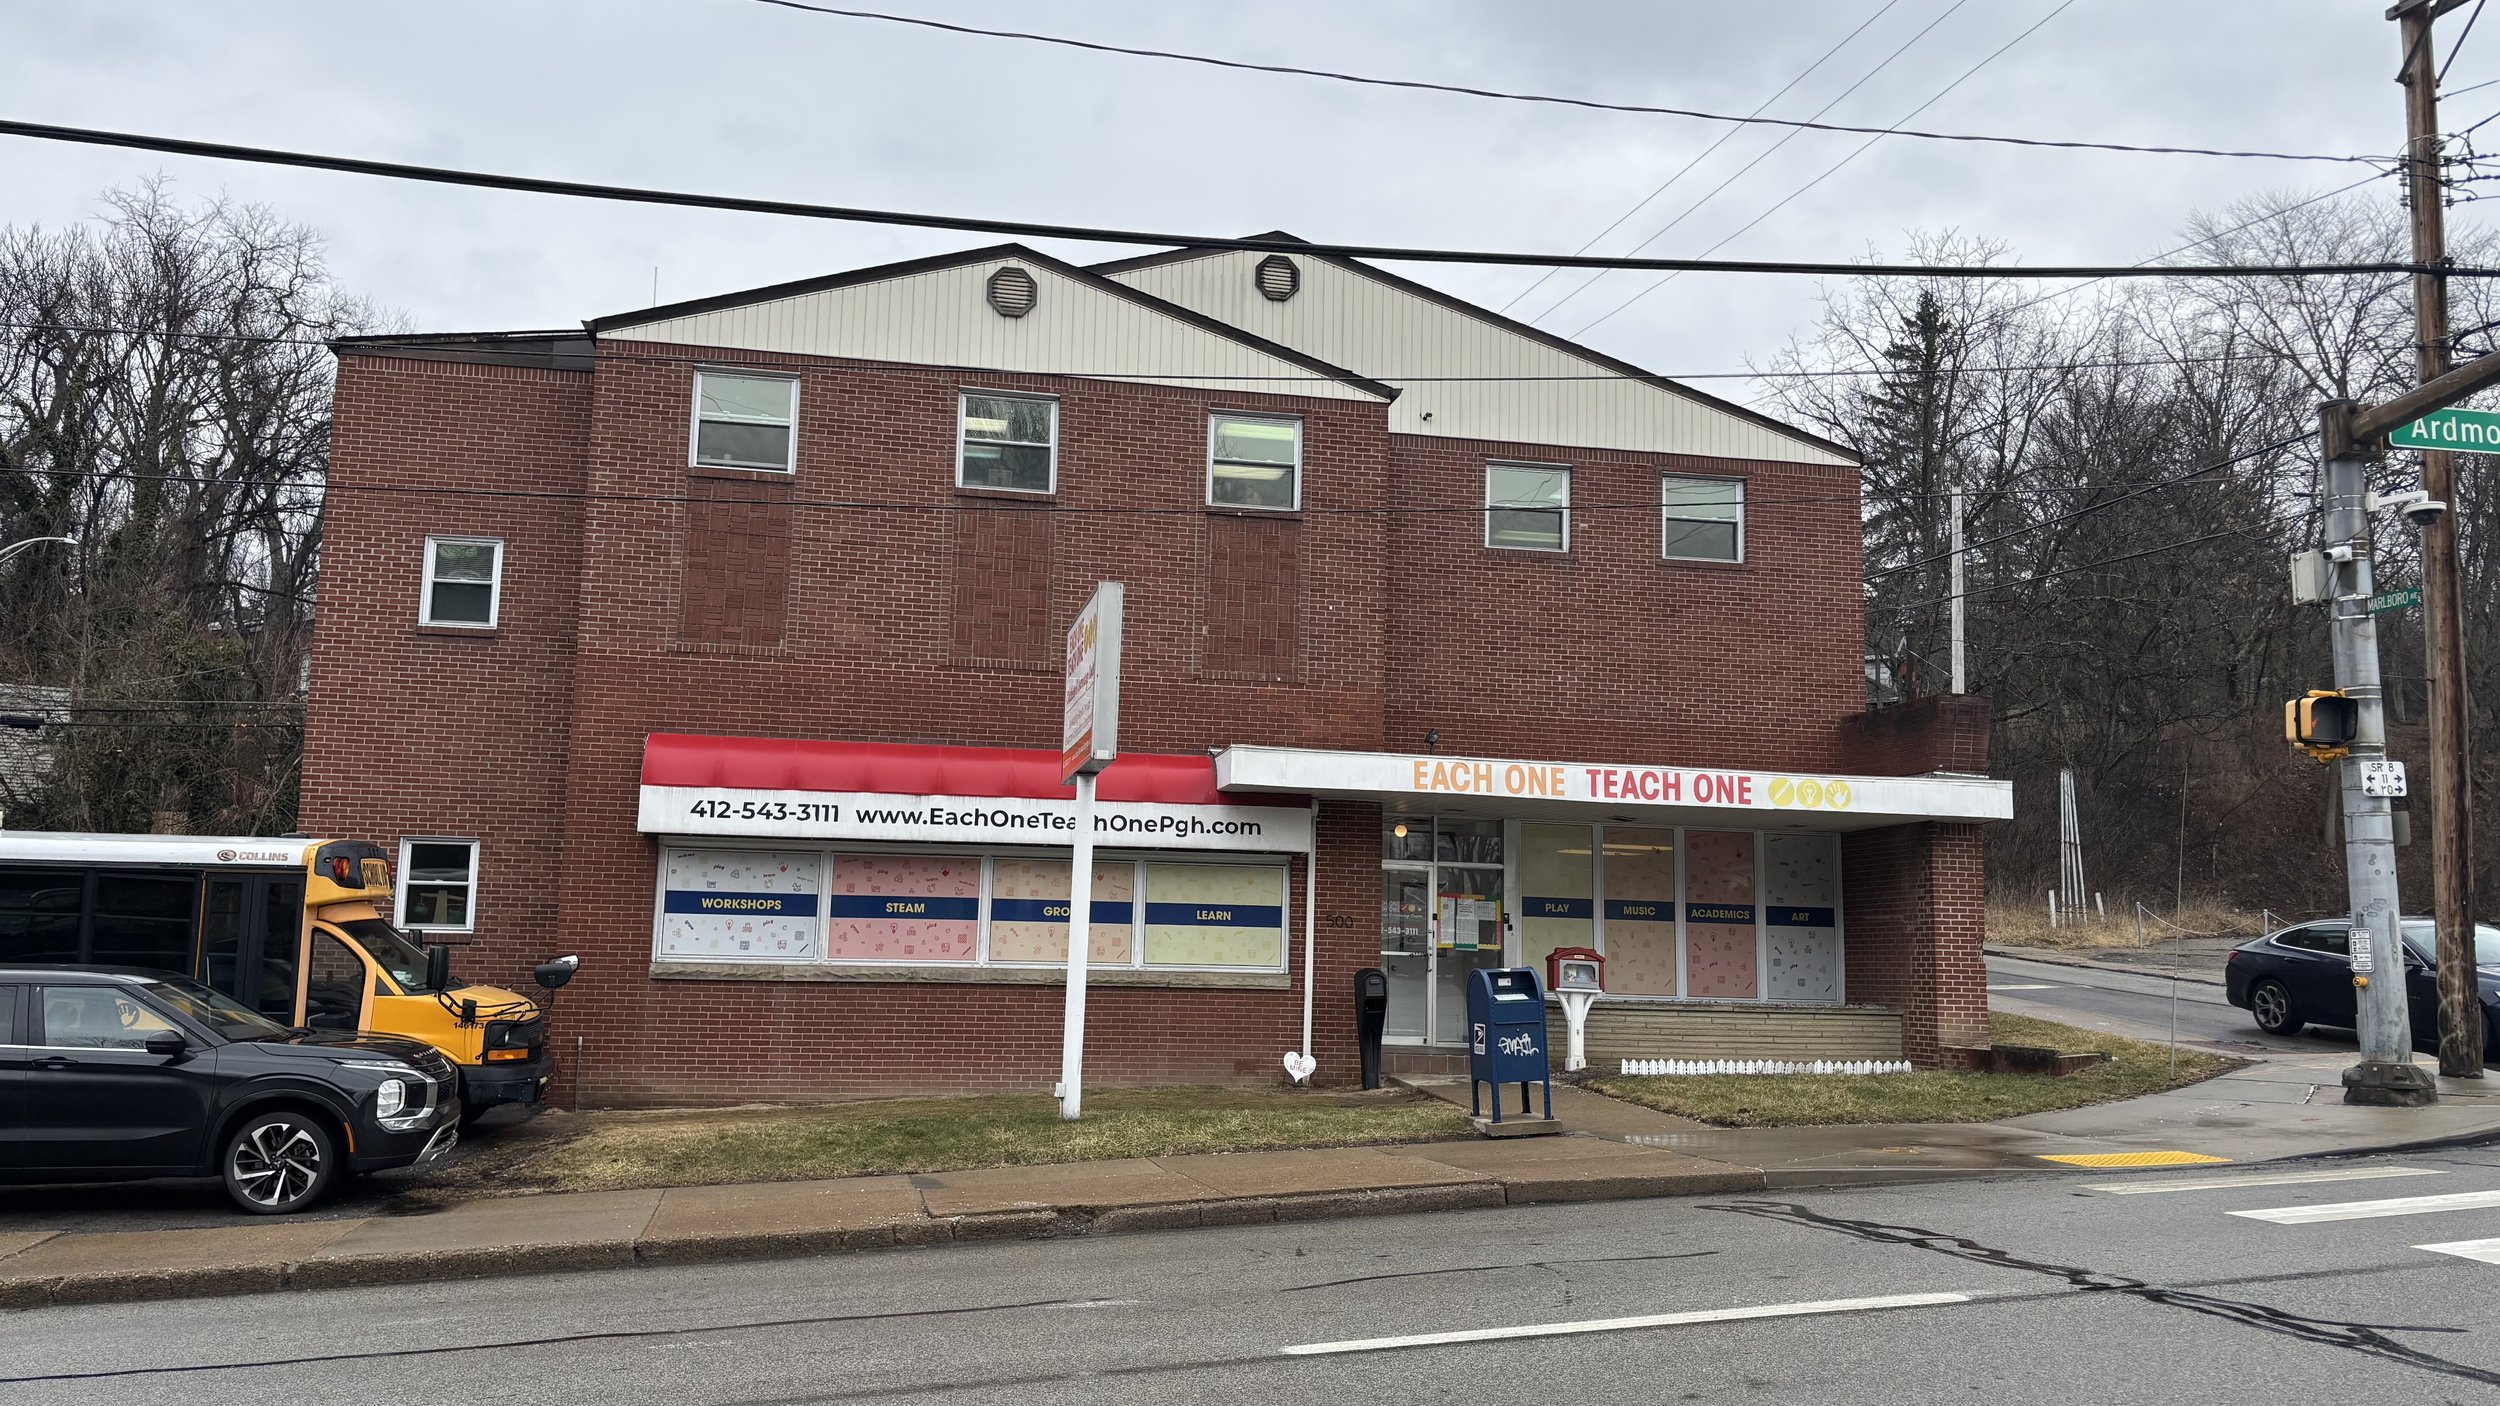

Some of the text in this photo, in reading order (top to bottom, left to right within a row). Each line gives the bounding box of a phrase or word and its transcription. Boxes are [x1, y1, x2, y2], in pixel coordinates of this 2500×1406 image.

[2411, 416, 2500, 445] Ardmo
[2367, 591, 2409, 612] MARLBORO
[2371, 762, 2395, 773] SR 8
[1413, 760, 1752, 805] EACH ONE TEACH ONE
[2381, 774, 2389, 784] 11
[690, 799, 1262, 838] 412-543-3111 www.EachOneTeahOnePgh.com
[238, 851, 289, 862] COLLINS
[701, 897, 782, 911] WORKSHOPS
[885, 902, 925, 913] STEAM
[1545, 903, 1570, 913] PLAY
[1043, 906, 1071, 917] GRO
[1196, 910, 1232, 921] LEARN
[1623, 906, 1656, 916] MUSIC
[1691, 908, 1750, 920] ACADEMICS
[1326, 914, 1354, 929] 500
[1791, 912, 1810, 922] ART
[1294, 1059, 1304, 1067] BE
[1289, 1064, 1308, 1074] MINE
